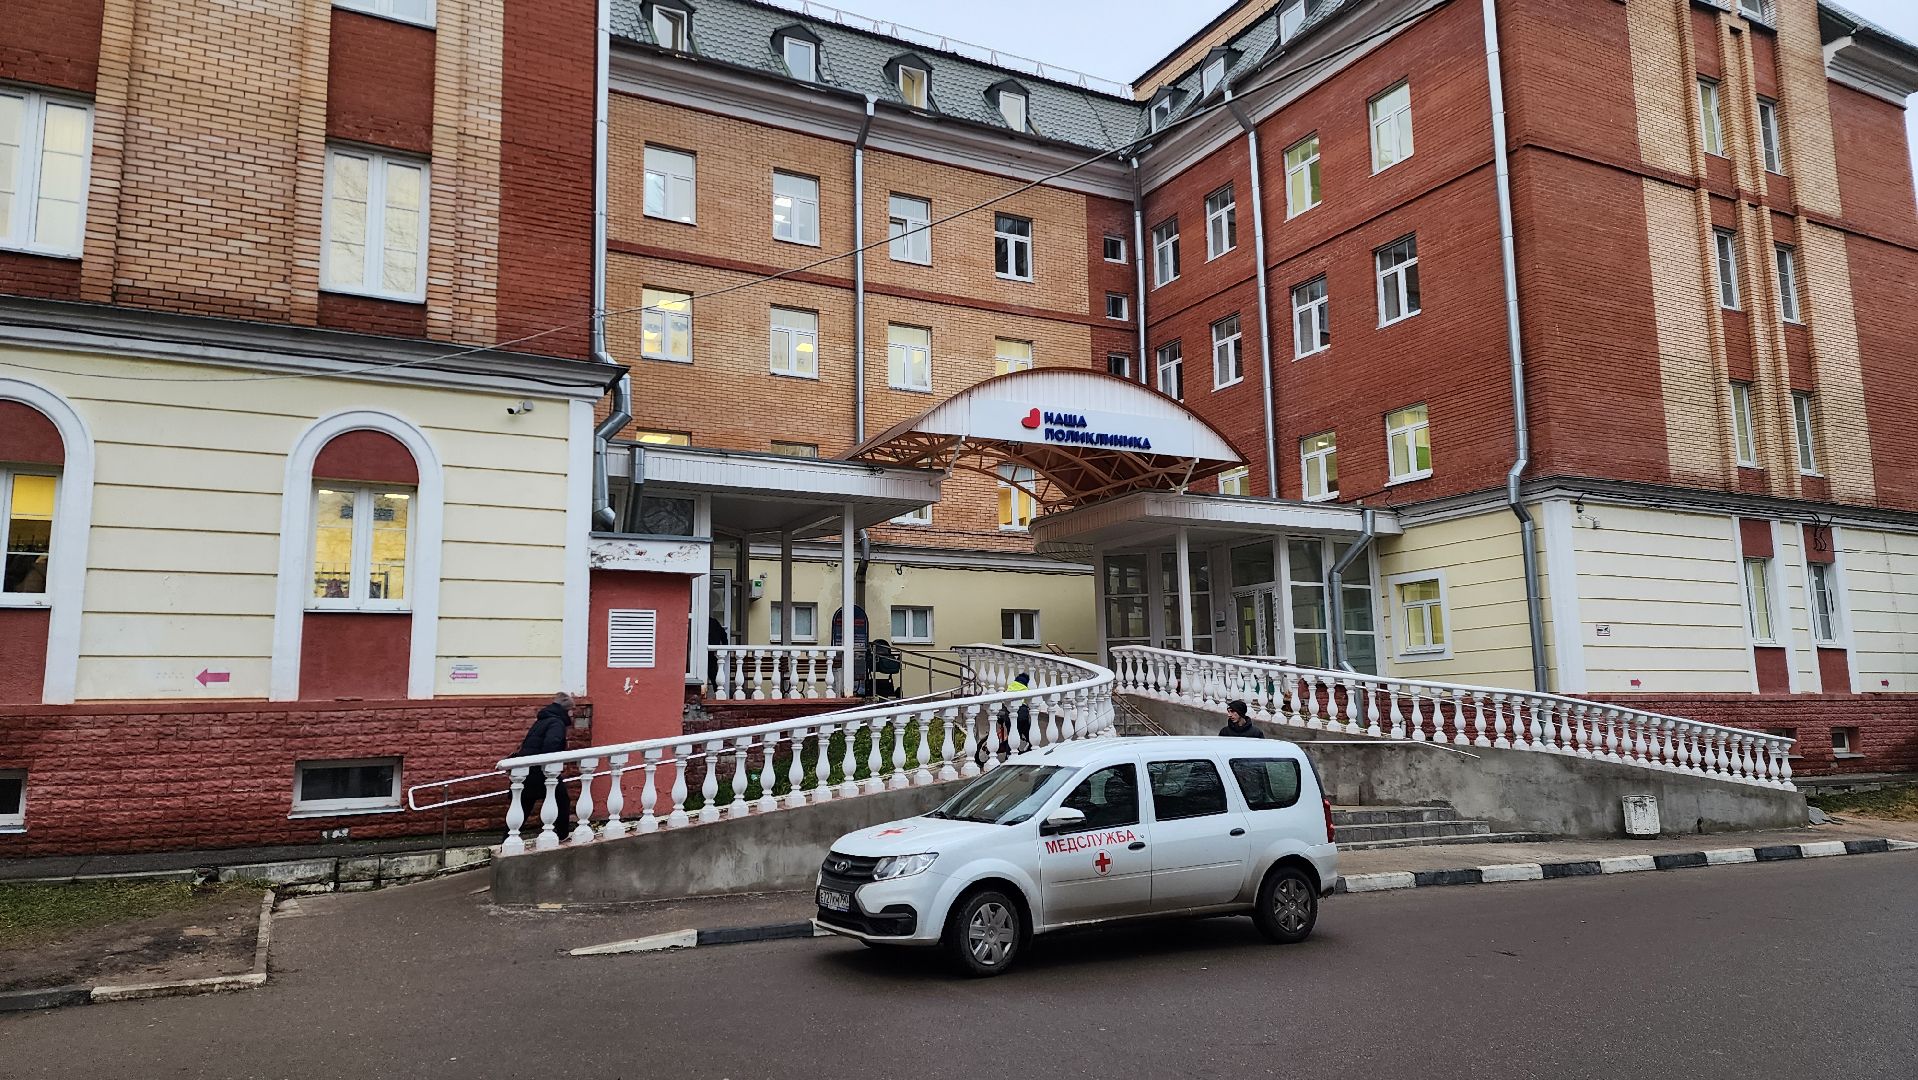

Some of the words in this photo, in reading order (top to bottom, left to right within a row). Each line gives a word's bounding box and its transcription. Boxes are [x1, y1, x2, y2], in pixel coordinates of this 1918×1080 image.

[1044, 411, 1087, 428] НАША
[1044, 428, 1151, 450] ПОЛИКЛИНИКА
[1045, 829, 1136, 854] МЕДСЛУЖБА
